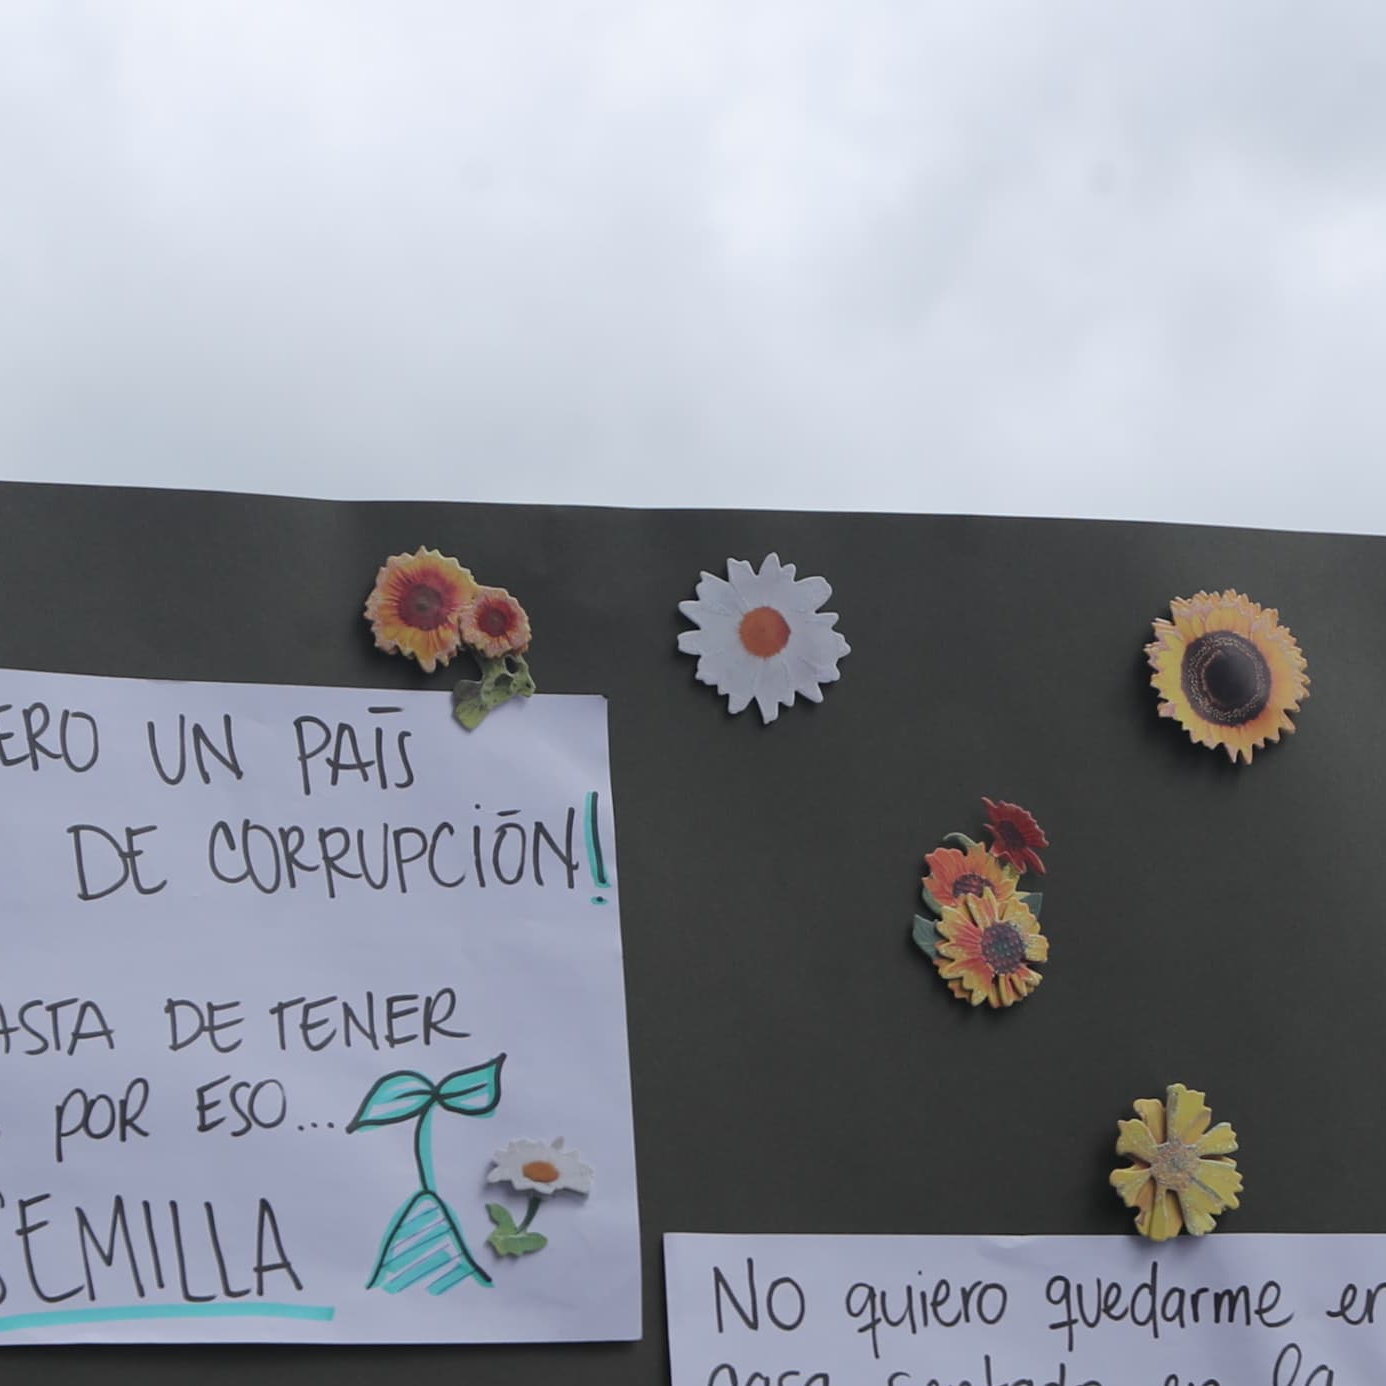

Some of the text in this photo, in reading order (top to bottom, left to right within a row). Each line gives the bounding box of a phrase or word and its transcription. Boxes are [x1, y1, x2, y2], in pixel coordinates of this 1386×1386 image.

[149, 714, 244, 787] UN
[294, 706, 416, 795] PAÍS
[67, 824, 168, 901] DE
[209, 792, 611, 906] CORRUPCIÓN!
[165, 998, 246, 1053] DE
[270, 987, 472, 1053] TENER
[54, 1077, 150, 1162] POR
[195, 1077, 335, 1137] ESO...
[713, 1258, 806, 1334] No
[845, 1270, 1008, 1358] quiero
[1045, 1261, 1294, 1352] quedarme
